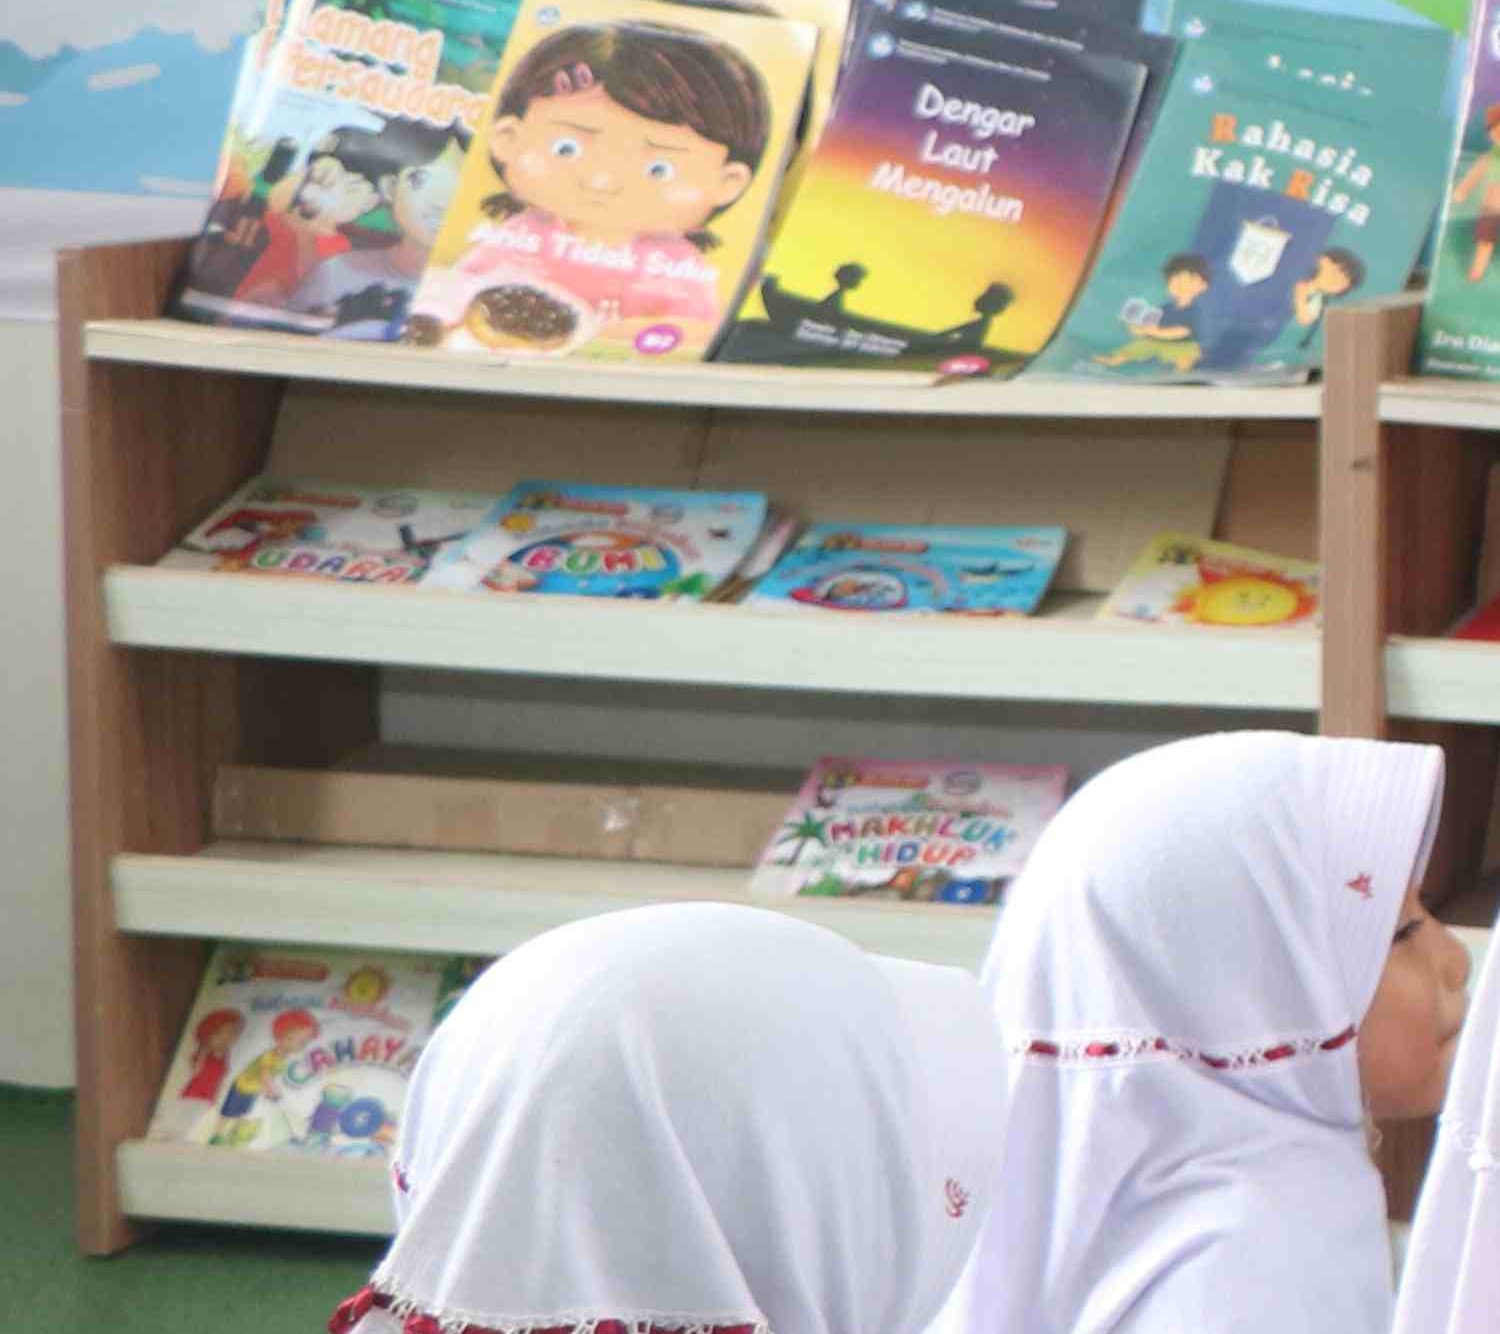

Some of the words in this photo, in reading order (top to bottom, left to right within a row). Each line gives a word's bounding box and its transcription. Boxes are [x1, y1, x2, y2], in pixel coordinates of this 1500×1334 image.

[914, 82, 1035, 139] Dengar
[921, 130, 998, 174] Laut
[1209, 112, 1373, 189] Rahasia
[870, 161, 1024, 222] Mengalun
[1189, 146, 1275, 190] Kak
[1284, 169, 1372, 227] Risa
[549, 230, 639, 272] Tidak
[525, 545, 665, 574] BUMI
[829, 815, 1017, 852] MAKHLUK
[856, 840, 978, 867] HIDUP
